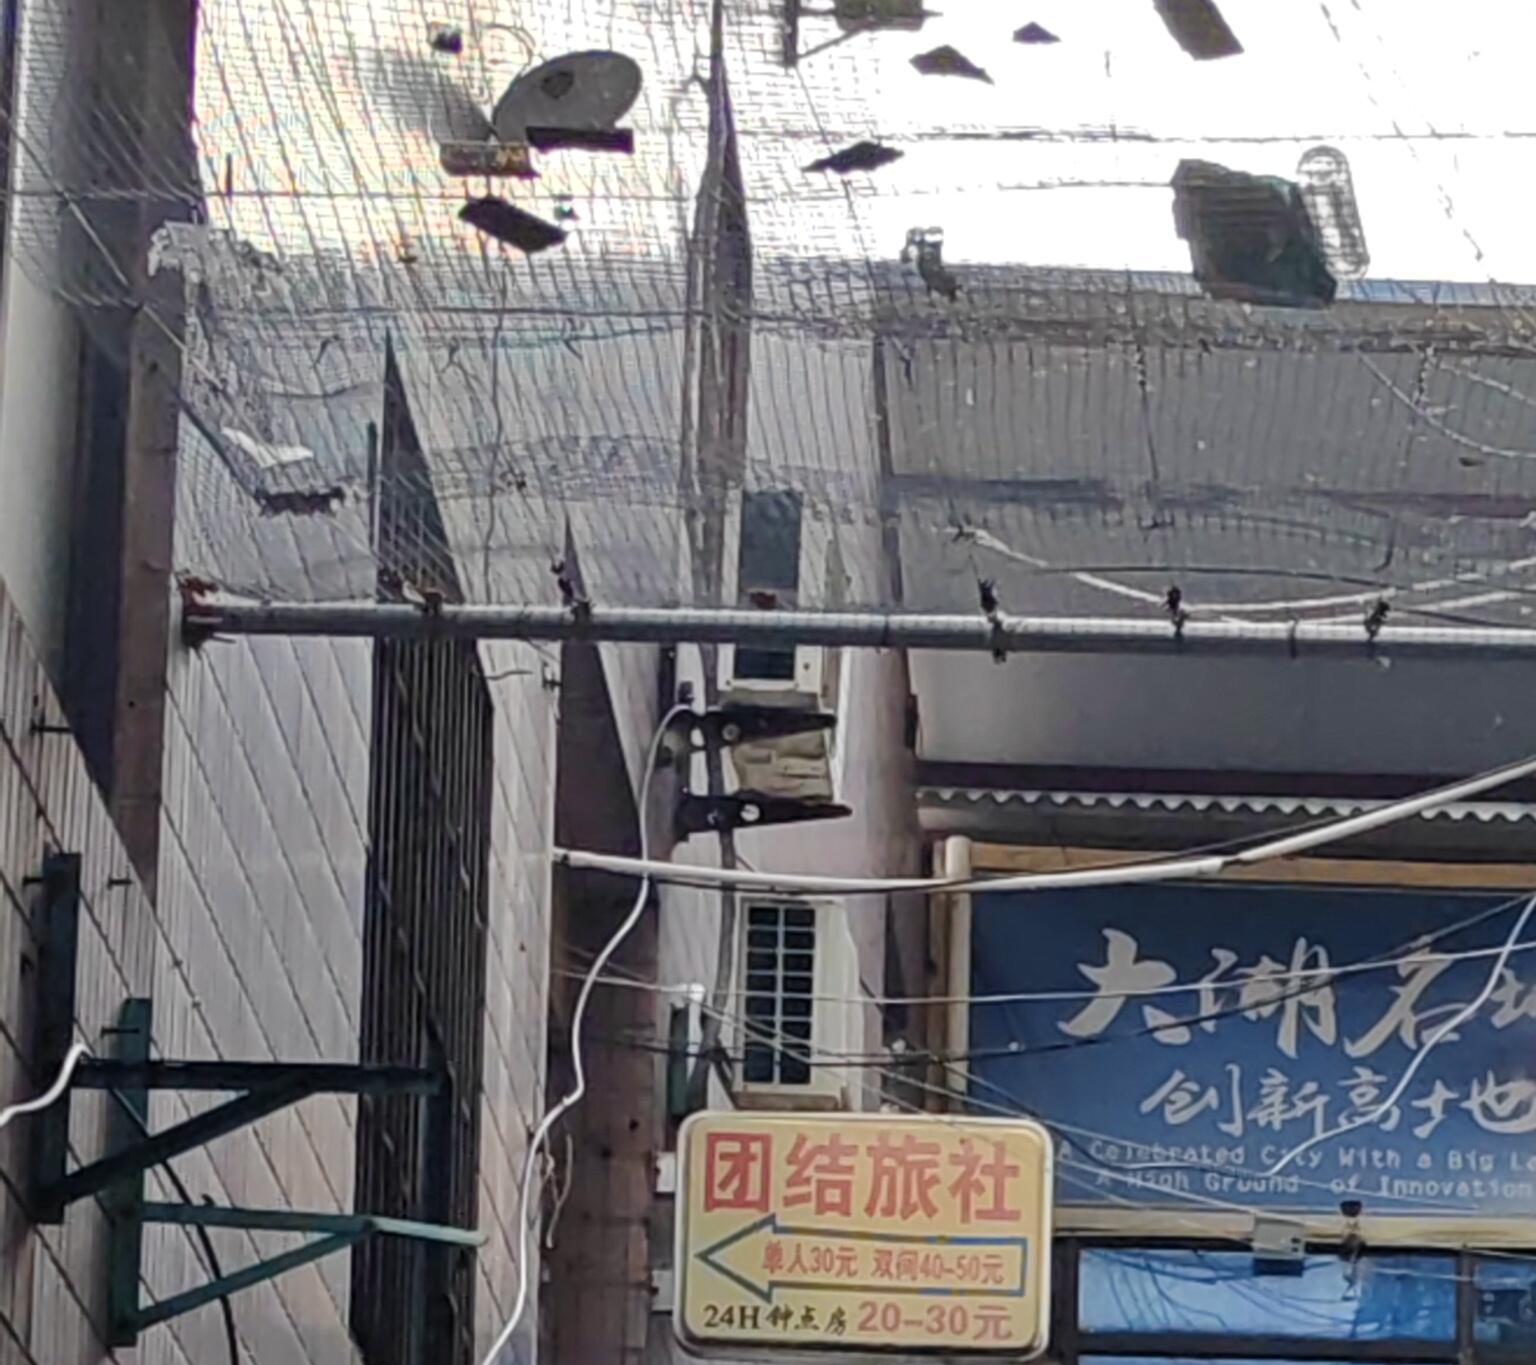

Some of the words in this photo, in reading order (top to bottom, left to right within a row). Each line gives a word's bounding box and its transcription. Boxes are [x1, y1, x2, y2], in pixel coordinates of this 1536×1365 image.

[1339, 1147, 1400, 1169] With
[1417, 1152, 1432, 1169] a
[1448, 1150, 1495, 1172] Big
[703, 1131, 1023, 1224] 团结旅社
[1205, 1173, 1298, 1192] Ground
[1330, 1173, 1360, 1194] of
[1380, 1175, 1535, 1199] Innovation
[762, 1240, 859, 1277] 单人30元
